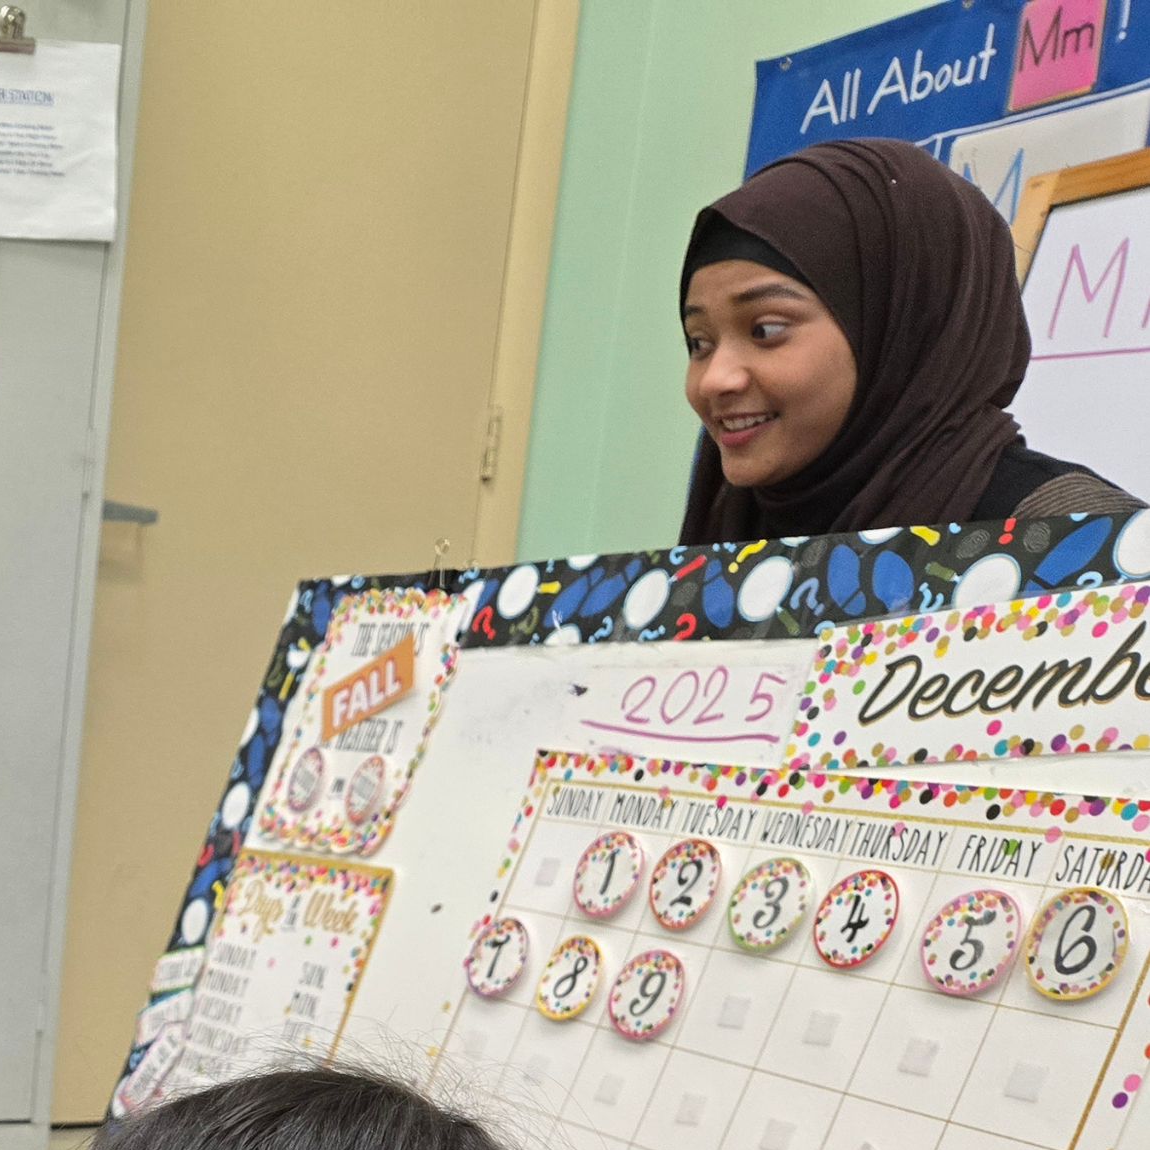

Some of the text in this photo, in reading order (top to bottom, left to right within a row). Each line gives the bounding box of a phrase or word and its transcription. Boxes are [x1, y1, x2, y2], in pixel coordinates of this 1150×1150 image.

[800, 68, 861, 134] All
[866, 23, 997, 115] About
[1018, 6, 1096, 74] Mm
[1048, 236, 1150, 340] M
[332, 657, 402, 730] FALL
[620, 664, 787, 726] 2025
[546, 786, 605, 820] SUNDAY
[608, 794, 679, 831] MONDAY
[681, 802, 759, 843] TUESDAY
[759, 810, 855, 854] WEDNESDAY
[851, 821, 948, 869] THURSDAY
[956, 833, 1044, 879] FRIDAY
[303, 890, 359, 935] Week
[598, 850, 1097, 976] 1 2 3 4 5 6
[485, 936, 667, 1016] 7 8 9
